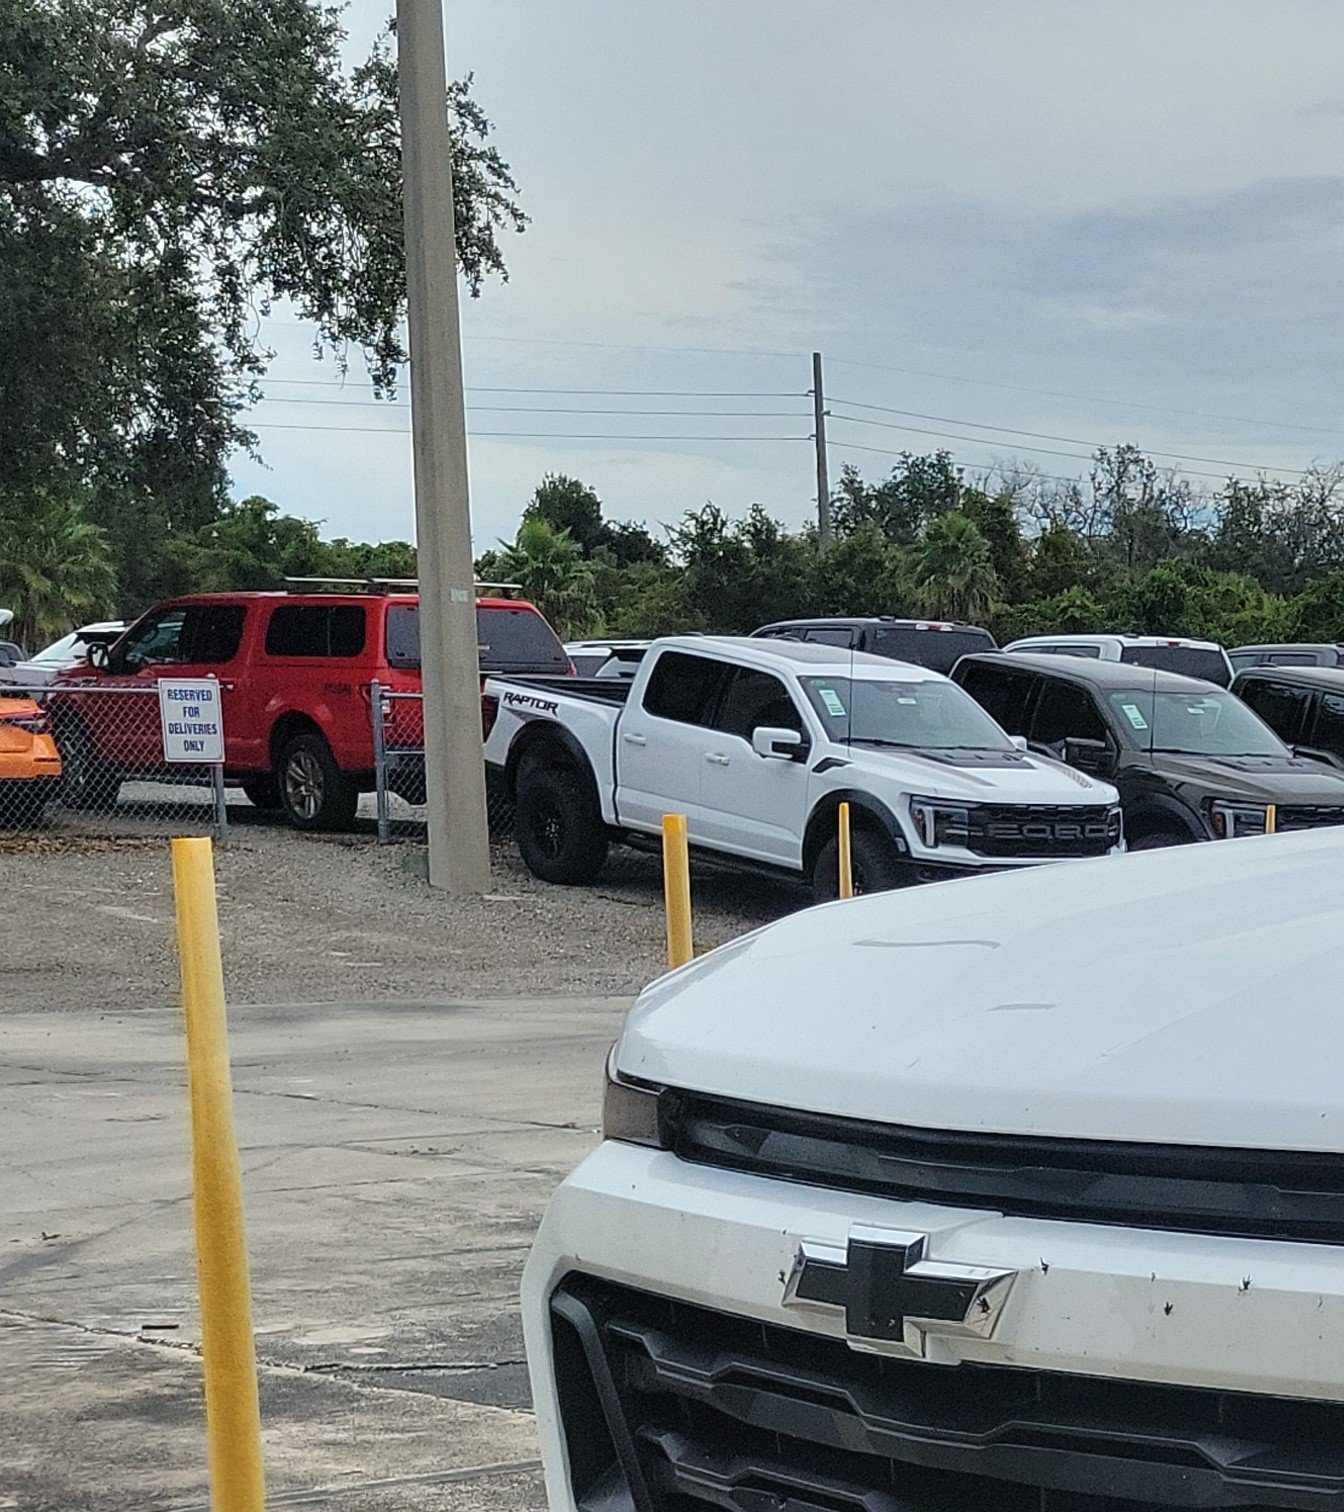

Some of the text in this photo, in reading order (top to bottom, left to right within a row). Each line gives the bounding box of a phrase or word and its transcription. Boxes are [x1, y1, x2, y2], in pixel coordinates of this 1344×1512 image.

[167, 689, 213, 701] RESERVED
[504, 691, 559, 717] RAPTOR
[183, 706, 200, 718] FOR
[168, 722, 217, 735] DELIVERIES
[184, 739, 205, 752] ONLY
[988, 822, 1110, 840] FORD
